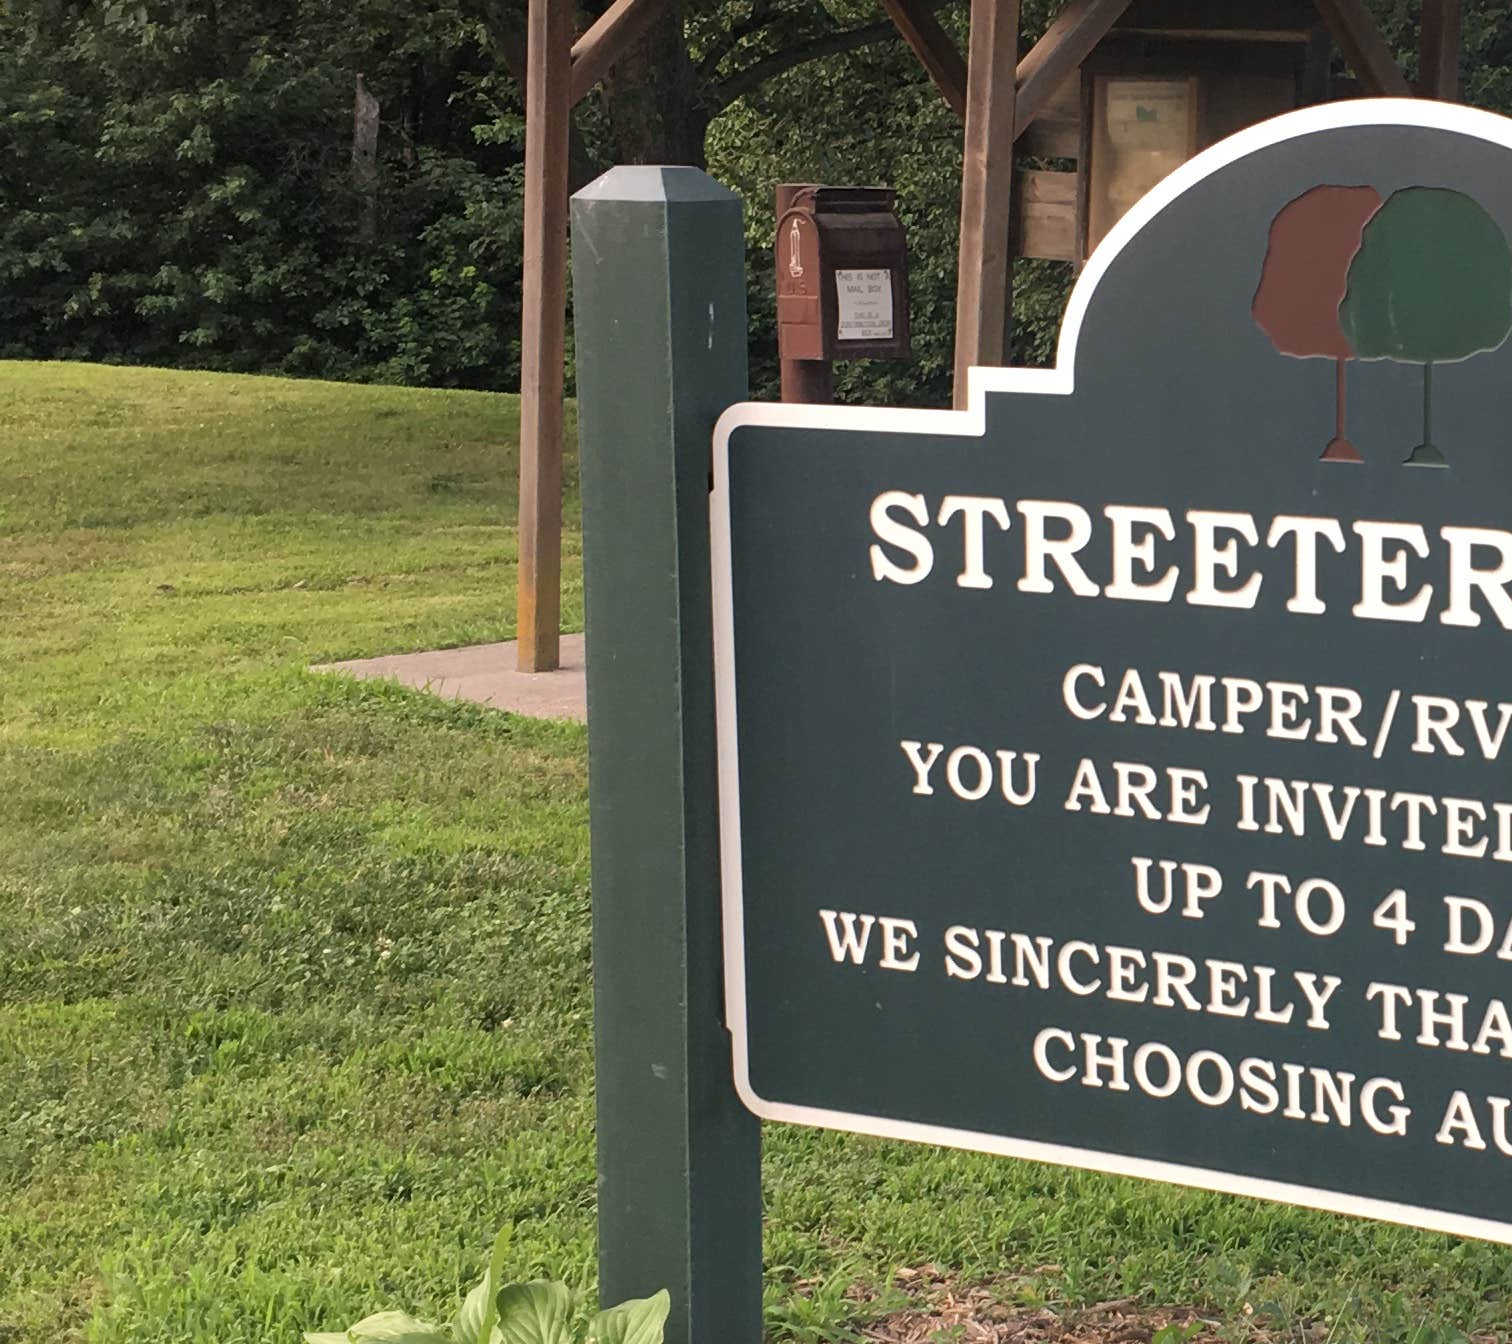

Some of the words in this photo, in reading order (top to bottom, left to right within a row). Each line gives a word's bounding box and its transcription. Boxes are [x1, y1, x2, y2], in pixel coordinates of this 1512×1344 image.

[900, 740, 1041, 806] YOU
[1064, 758, 1211, 825] ARE
[1131, 856, 1223, 919] UP
[1246, 871, 1346, 936] TO
[1373, 889, 1416, 946] 4
[819, 909, 921, 972] WE
[944, 925, 1342, 1030] SINCERELY
[1033, 1027, 1412, 1136] CHOOSING
